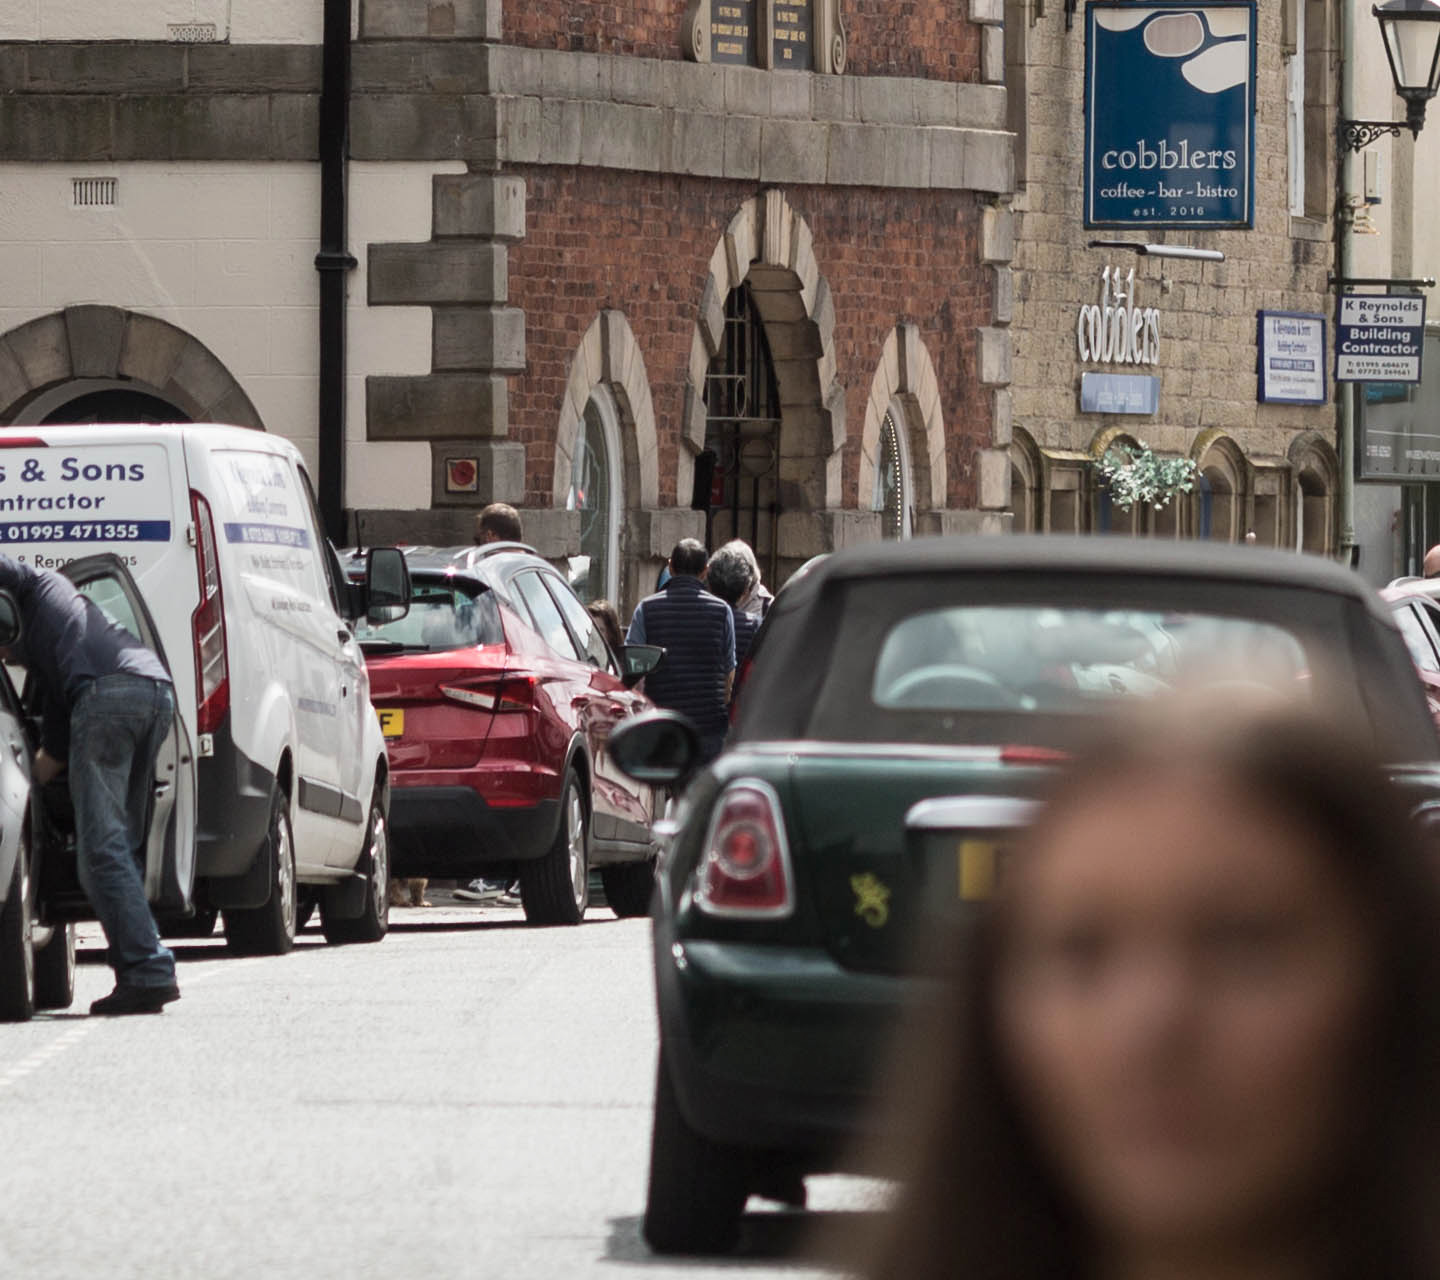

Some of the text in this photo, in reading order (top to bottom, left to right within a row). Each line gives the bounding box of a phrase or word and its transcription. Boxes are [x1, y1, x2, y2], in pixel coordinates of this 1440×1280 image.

[1101, 138, 1237, 170] cobblers
[1100, 181, 1146, 198] coffee
[1158, 181, 1184, 198] bar
[1196, 181, 1238, 198] bistro
[1132, 206, 1205, 217] est. 2016
[1345, 300, 1419, 313] K Reynolds
[1078, 265, 1160, 365] cobblers
[1358, 313, 1404, 324] & Sons
[1349, 327, 1411, 343] Building
[1341, 341, 1419, 355] Contractor
[20, 458, 46, 483] &
[60, 456, 145, 483] Sons
[7, 524, 65, 541] 01995
[70, 523, 140, 539] 471355
